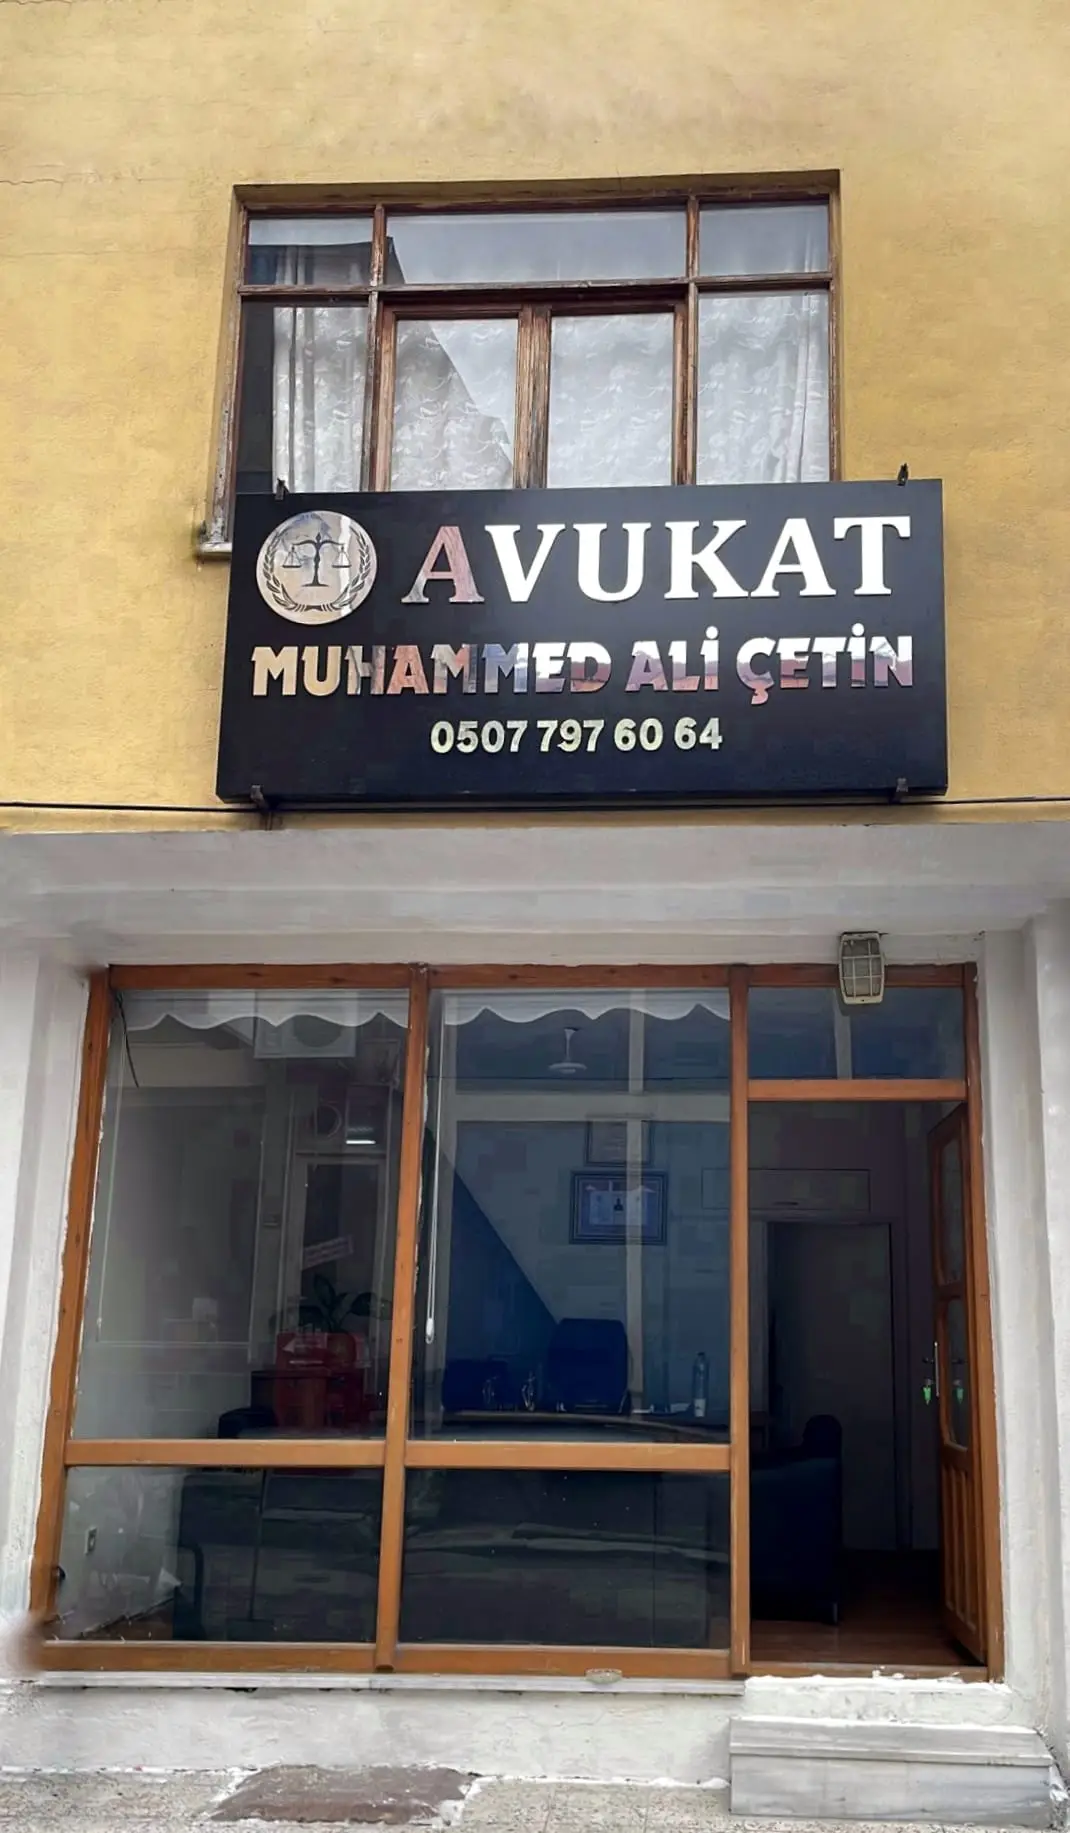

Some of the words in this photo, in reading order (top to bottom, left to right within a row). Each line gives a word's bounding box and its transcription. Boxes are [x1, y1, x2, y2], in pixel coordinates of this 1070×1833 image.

[401, 516, 911, 604] AVUKAT
[251, 641, 612, 696] MUHAMMED
[625, 626, 720, 692] ALİ
[736, 623, 913, 705] ÇETİN
[430, 720, 528, 753] 0507
[537, 719, 605, 753] 797
[614, 718, 664, 751] 60
[674, 717, 723, 750] 64
